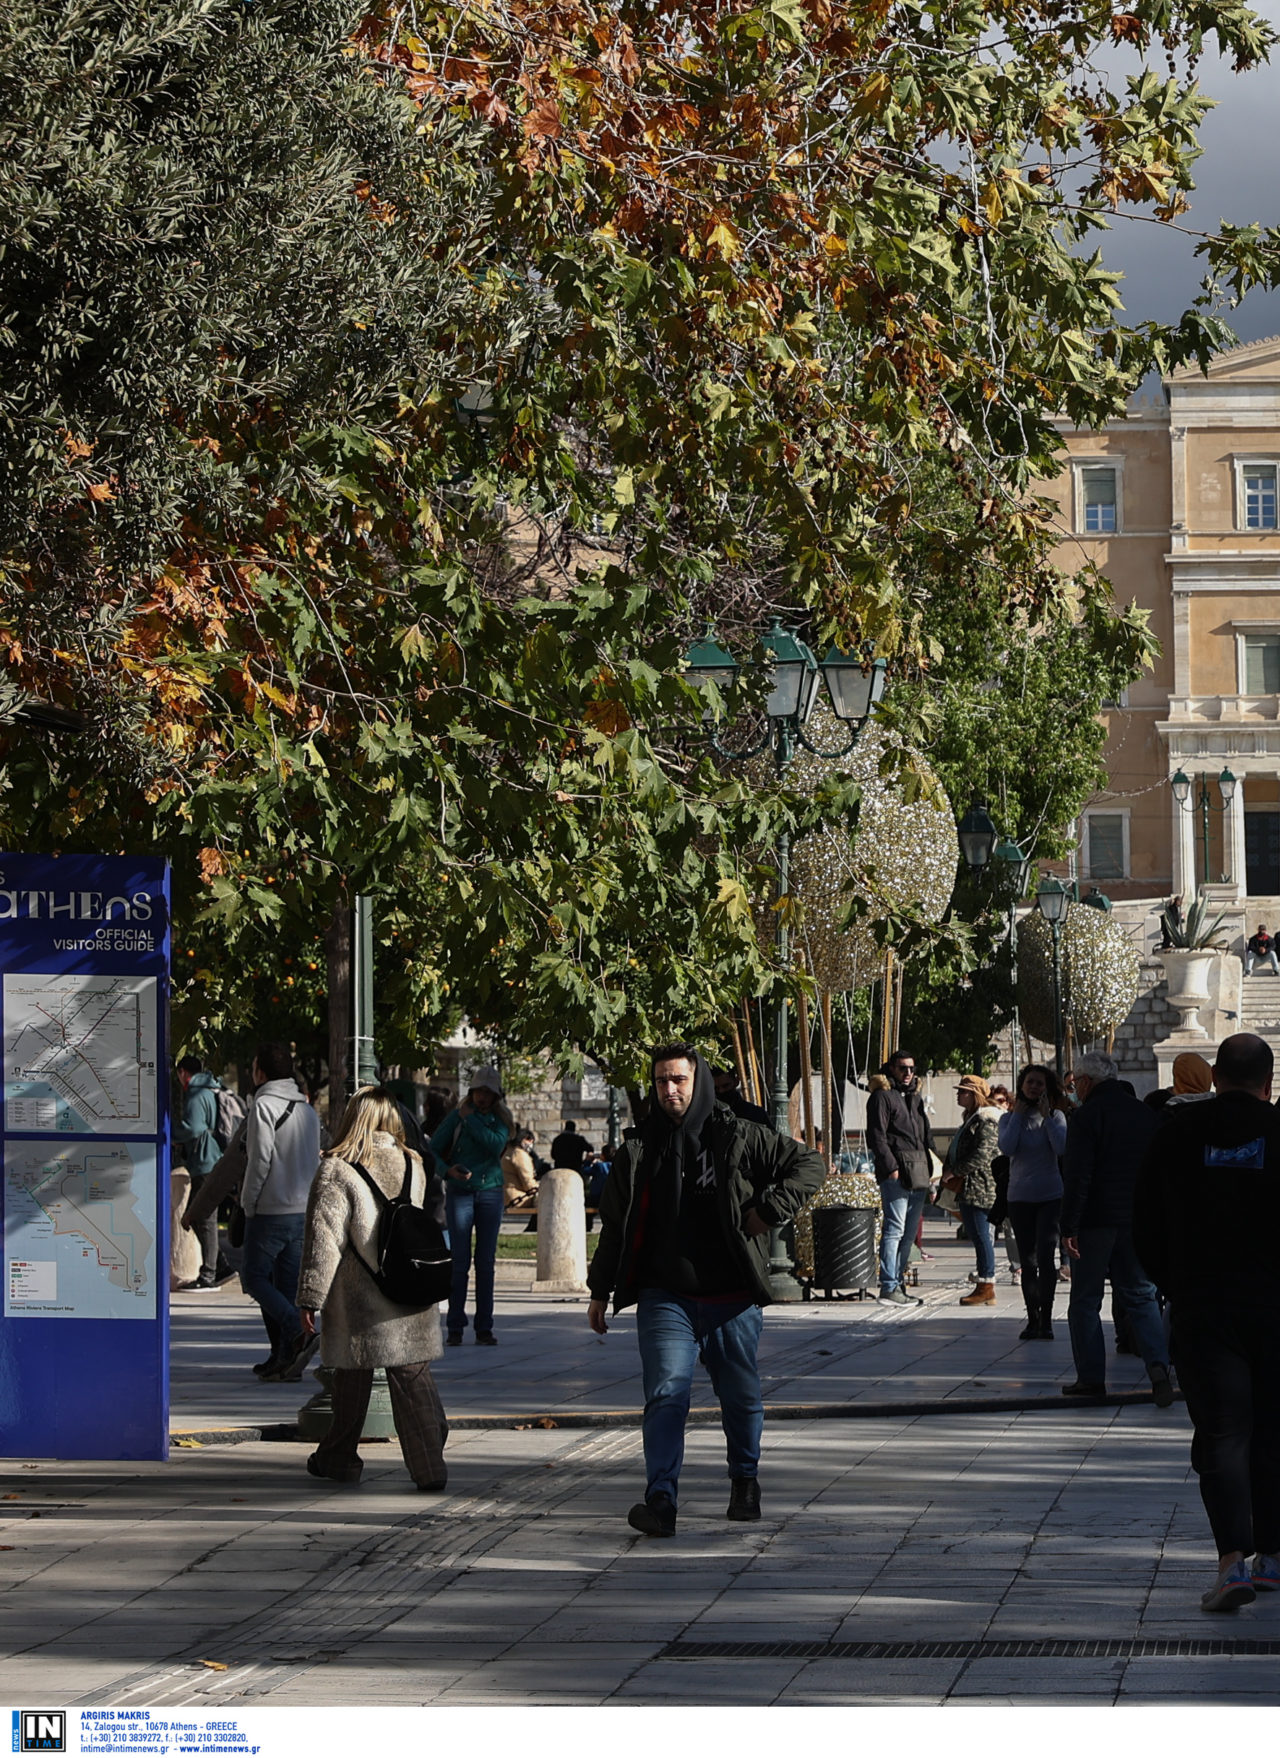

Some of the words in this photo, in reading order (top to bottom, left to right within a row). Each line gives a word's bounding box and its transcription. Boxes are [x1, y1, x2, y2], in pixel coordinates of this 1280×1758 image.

[95, 928, 155, 940] OFFICIAL
[53, 939, 112, 951] VISITORS
[114, 940, 155, 952] GUIDE
